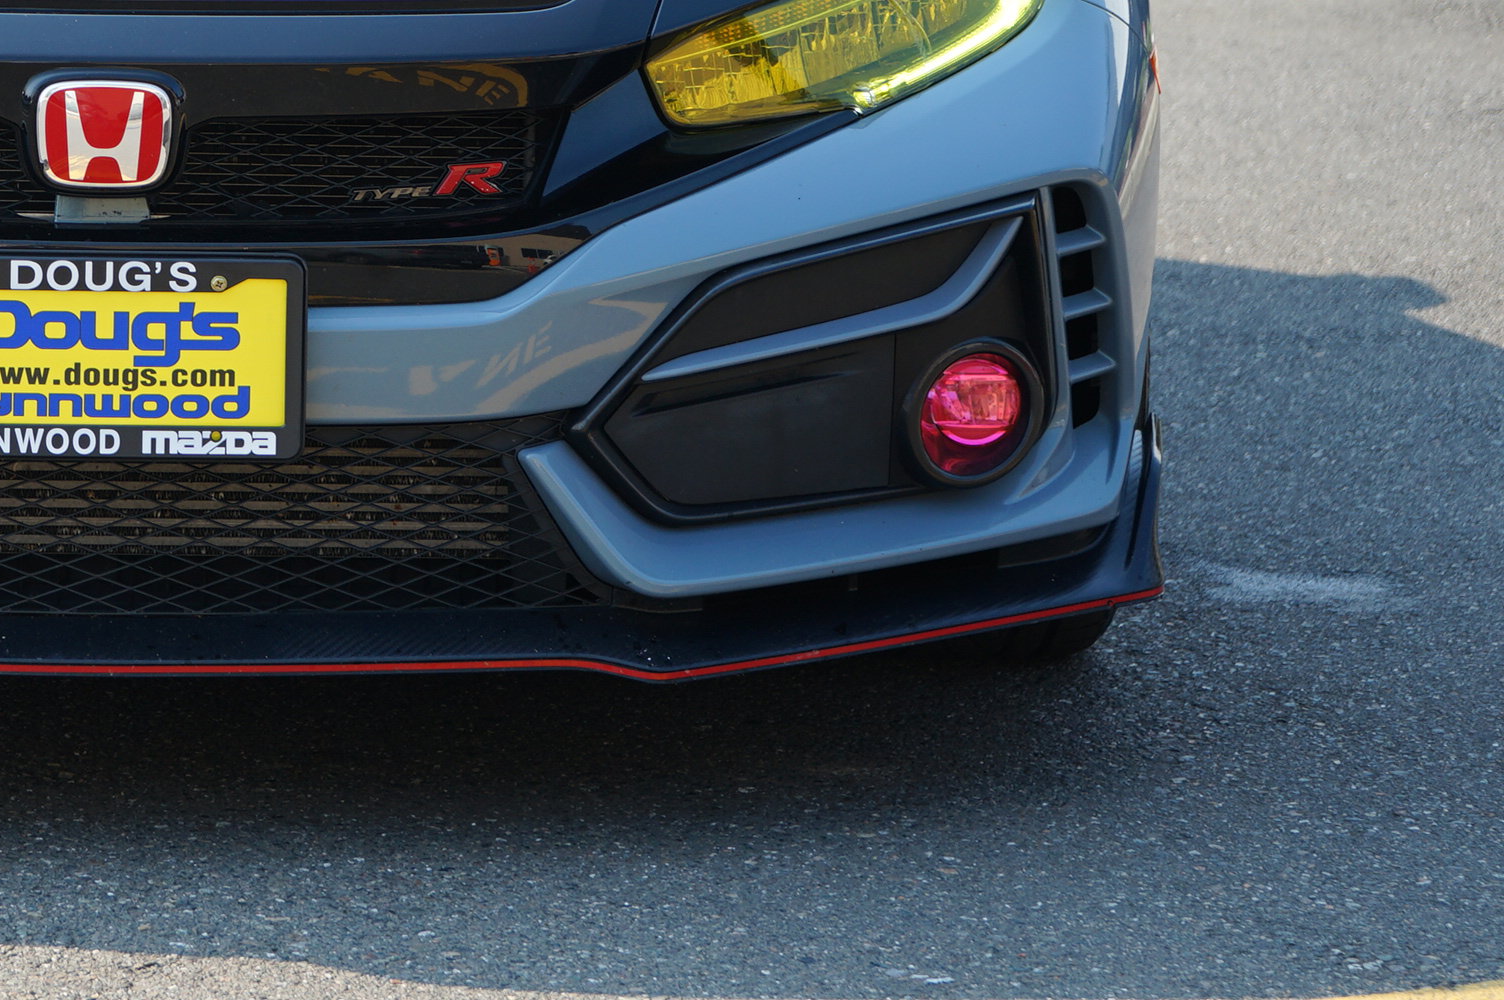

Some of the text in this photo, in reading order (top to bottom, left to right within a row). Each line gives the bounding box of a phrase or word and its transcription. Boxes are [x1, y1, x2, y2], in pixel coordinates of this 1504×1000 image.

[352, 160, 509, 202] TYPE R
[9, 259, 197, 292] DOUG'S
